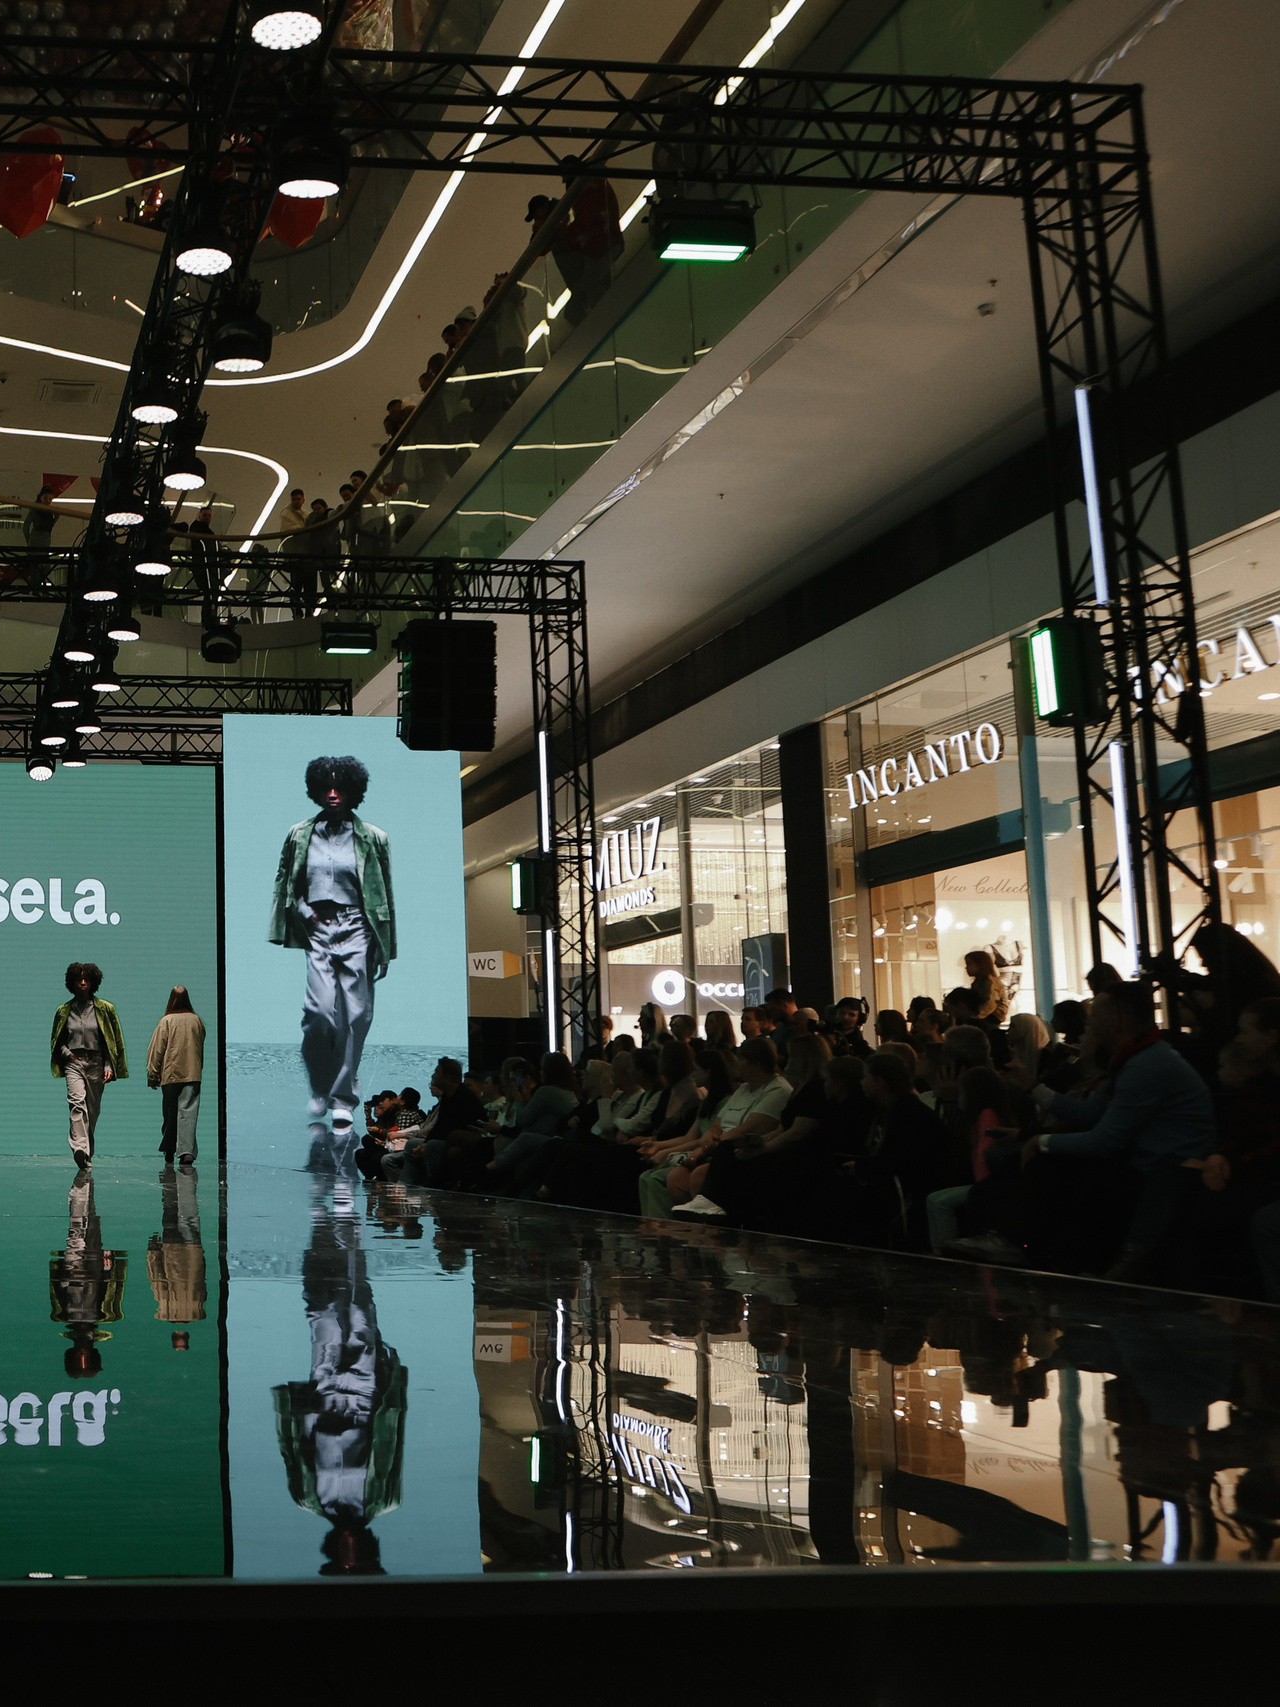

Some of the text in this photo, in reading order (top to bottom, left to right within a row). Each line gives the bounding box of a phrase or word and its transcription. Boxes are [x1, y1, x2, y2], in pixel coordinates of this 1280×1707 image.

[844, 722, 1002, 809] INCANTO
[581, 816, 664, 892] MIUZ
[934, 875, 968, 893] New
[599, 886, 656, 918] DIAMONDS
[473, 958, 497, 970] WC
